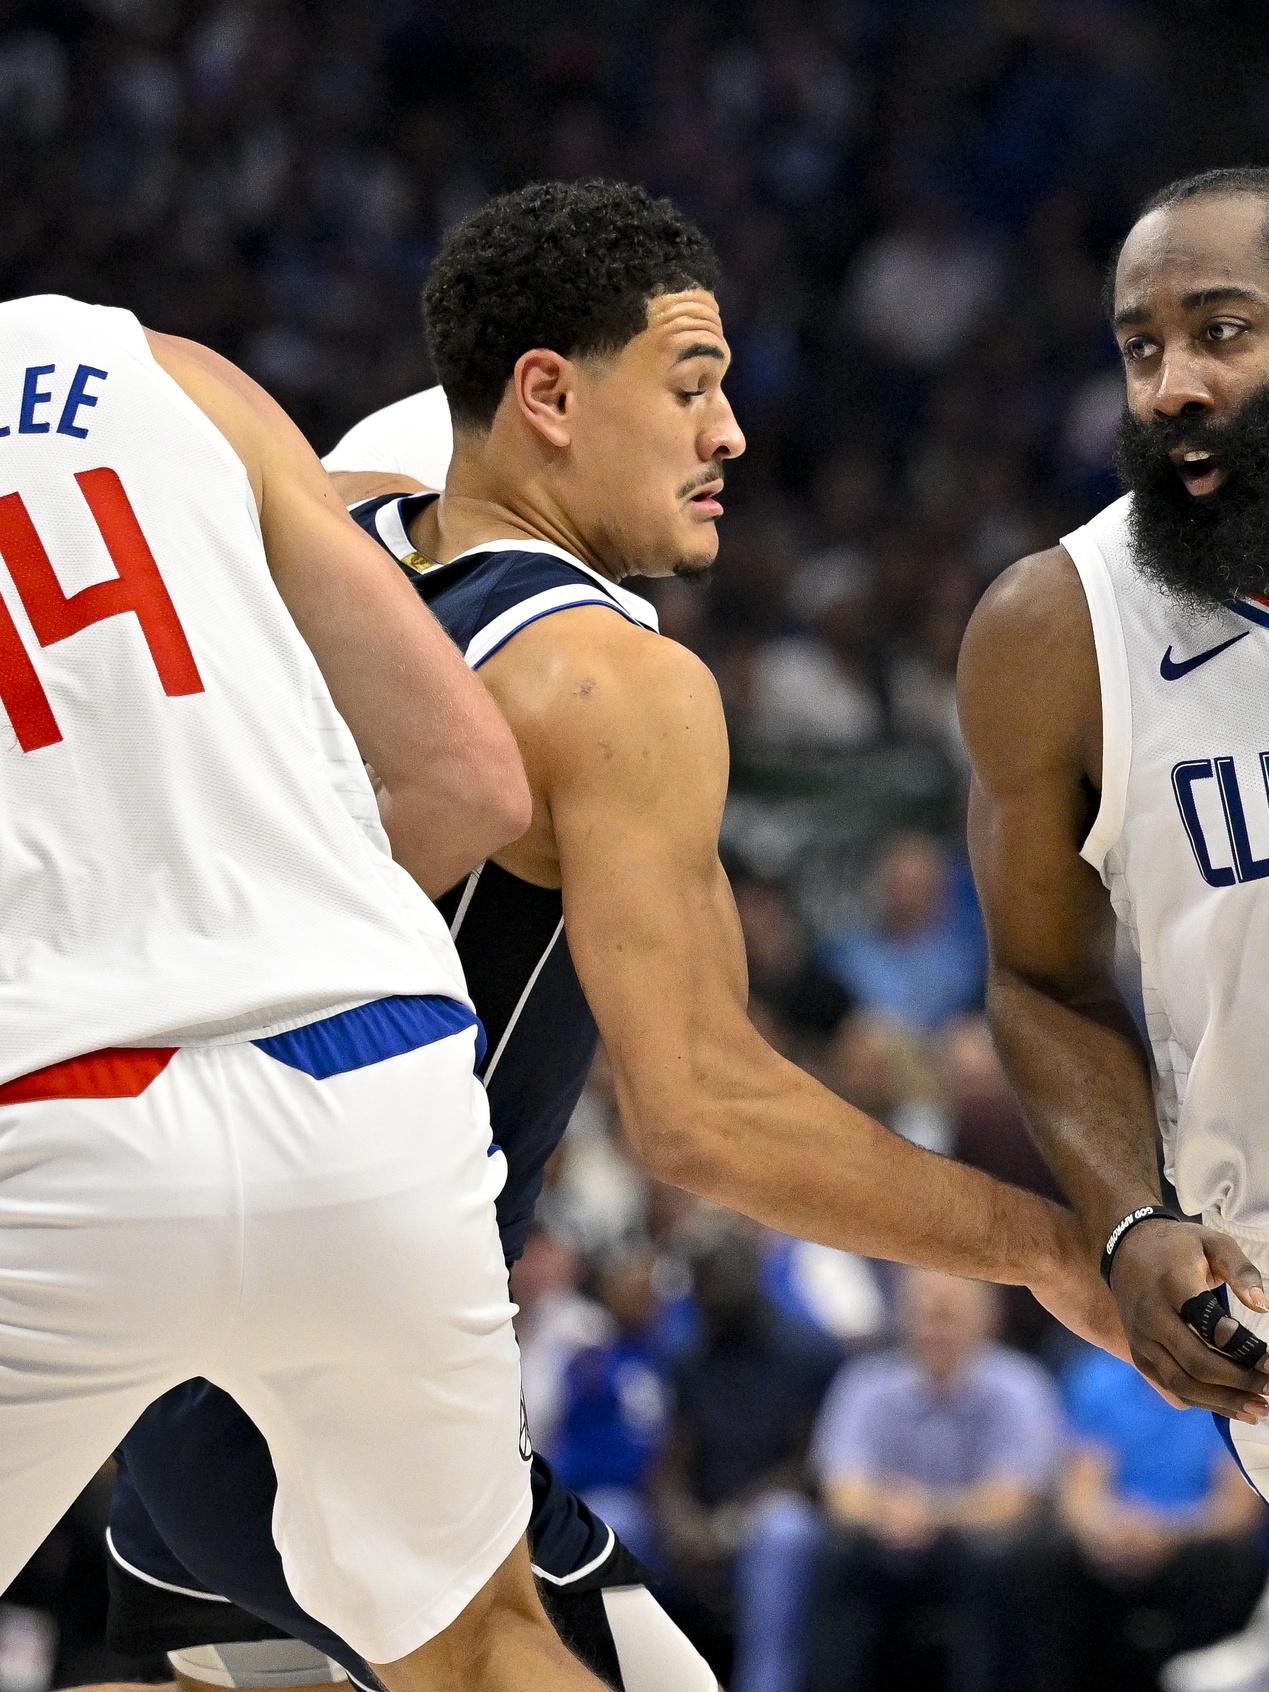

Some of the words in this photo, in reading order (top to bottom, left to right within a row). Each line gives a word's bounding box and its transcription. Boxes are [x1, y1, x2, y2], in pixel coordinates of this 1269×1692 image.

[0, 364, 108, 439] EE
[1134, 1206, 1154, 1219] GOD
[1106, 1214, 1134, 1255] APPROVED
